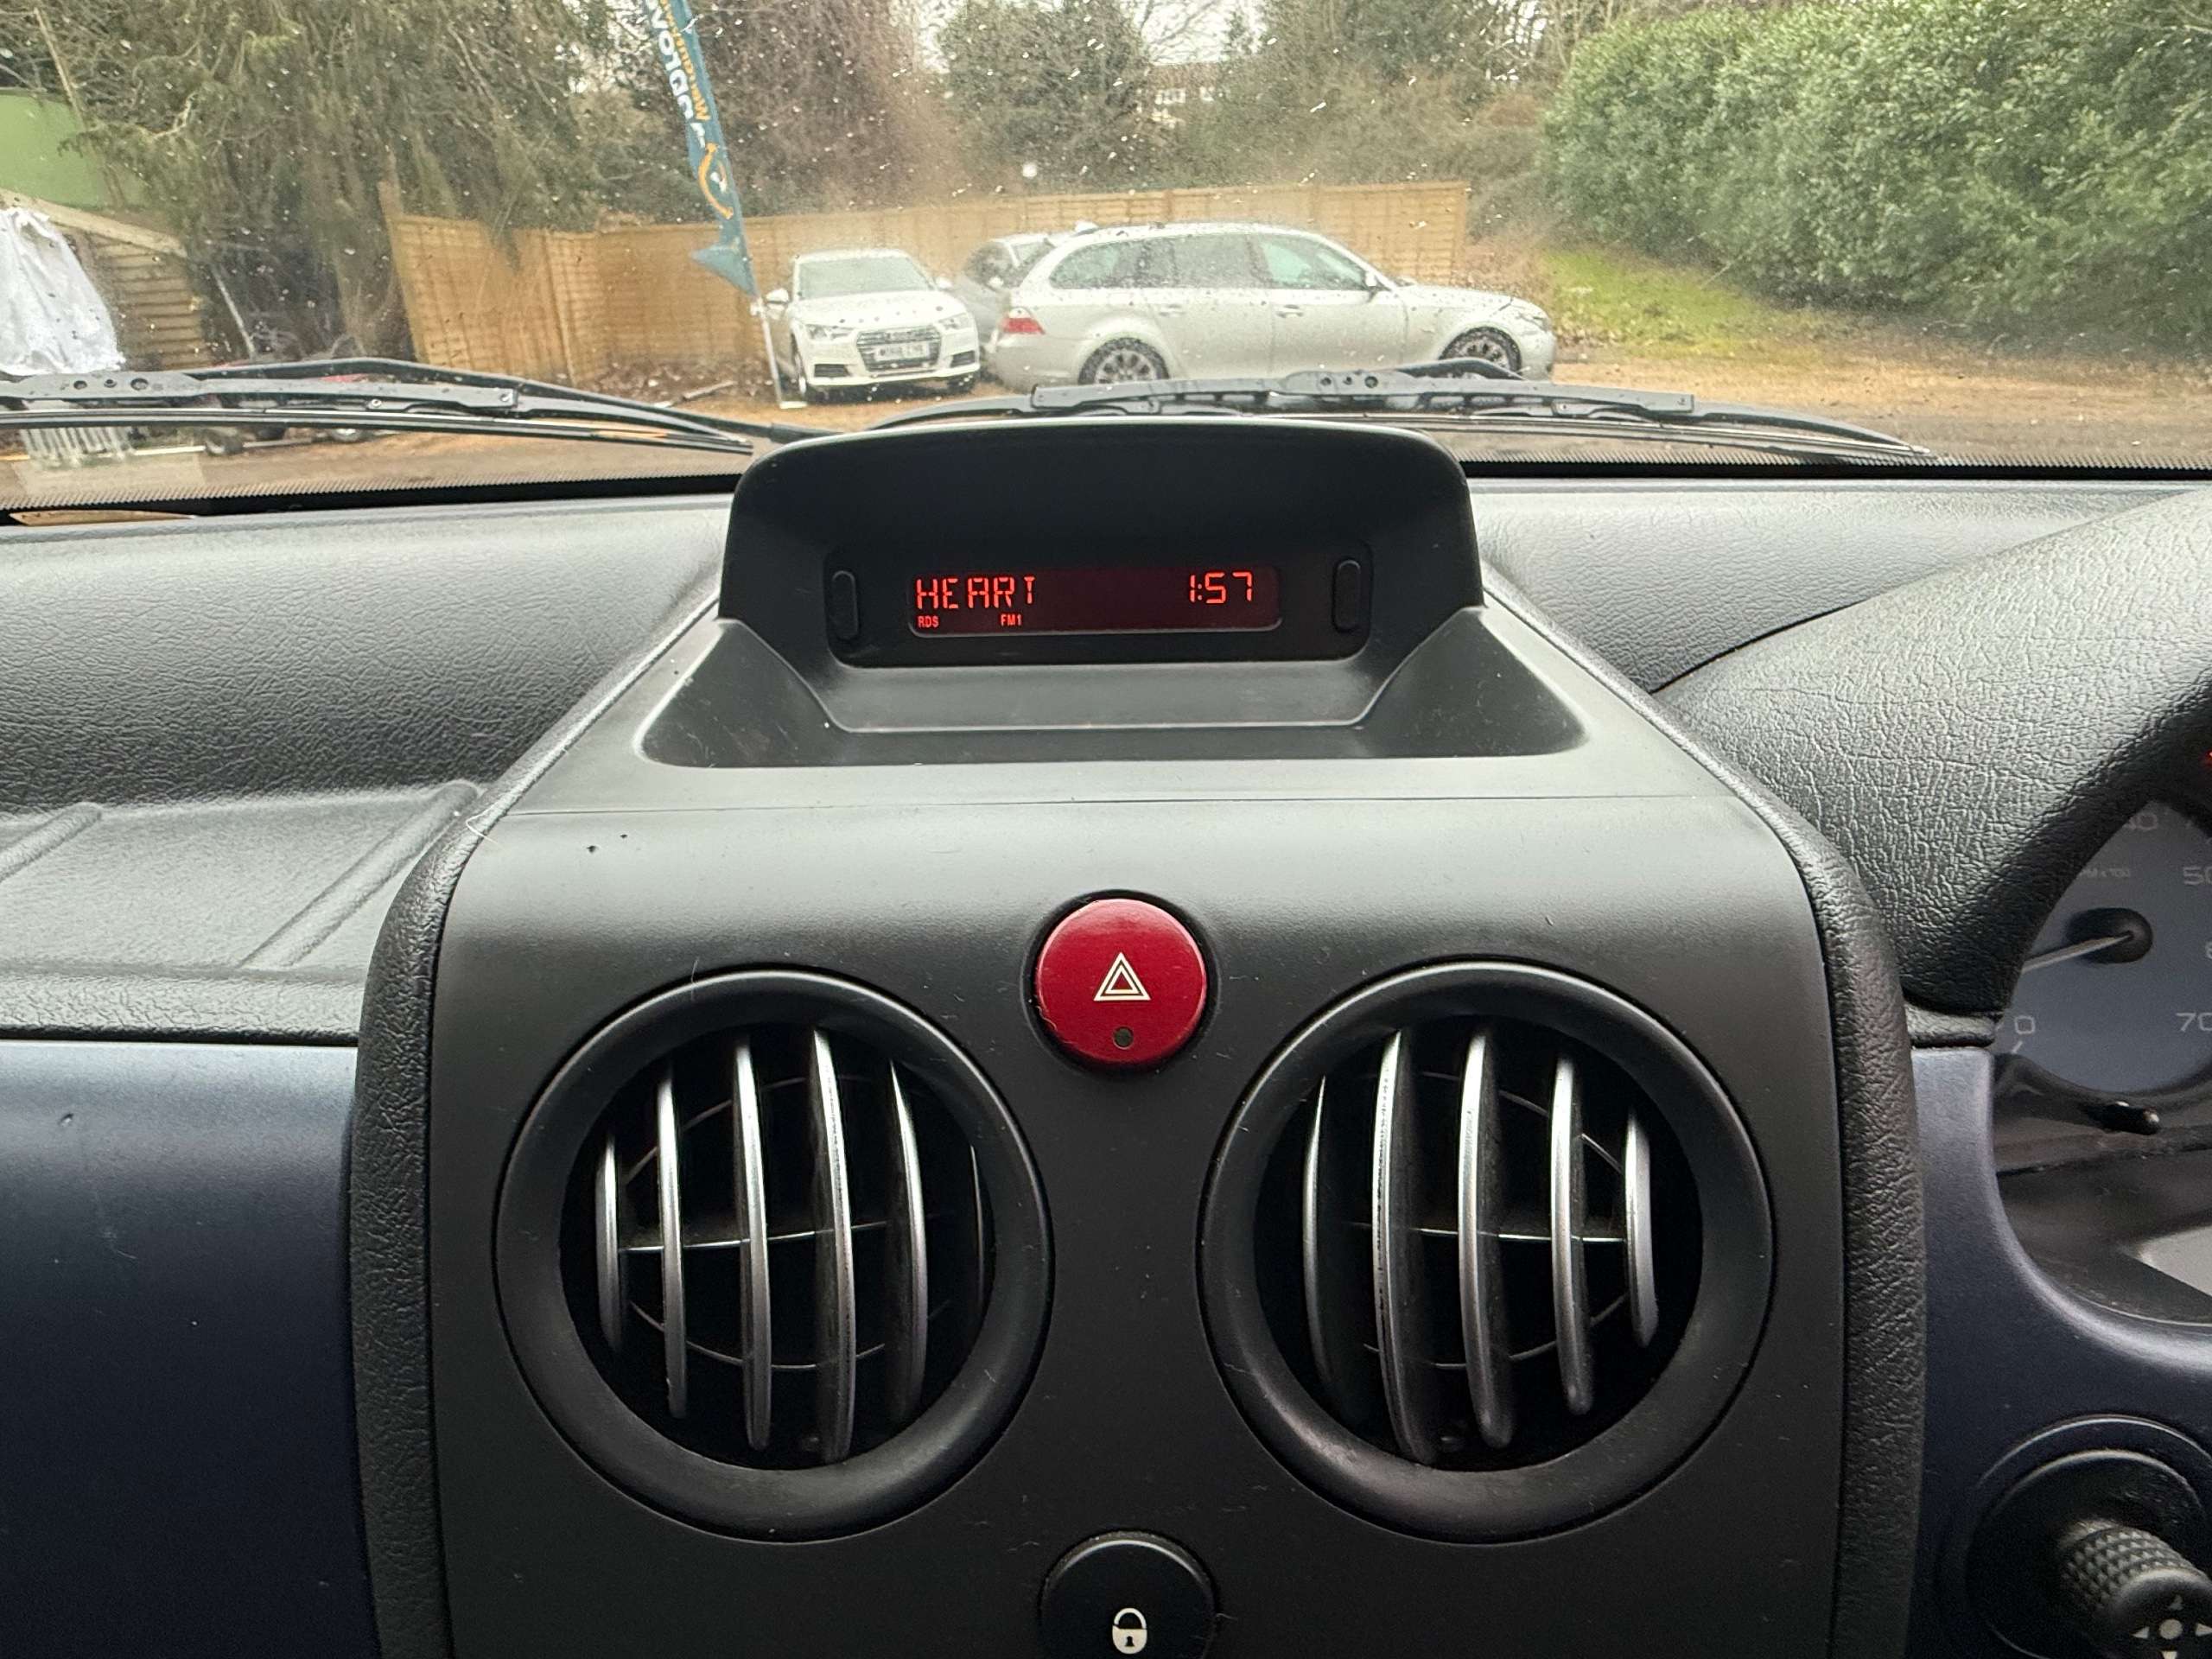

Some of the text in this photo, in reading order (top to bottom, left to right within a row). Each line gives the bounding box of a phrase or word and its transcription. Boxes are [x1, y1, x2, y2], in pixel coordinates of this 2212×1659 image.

[916, 575, 1035, 609] HEART
[1189, 571, 1253, 603] 1:57
[917, 614, 939, 628] RDS
[1000, 613, 1022, 626] FM1
